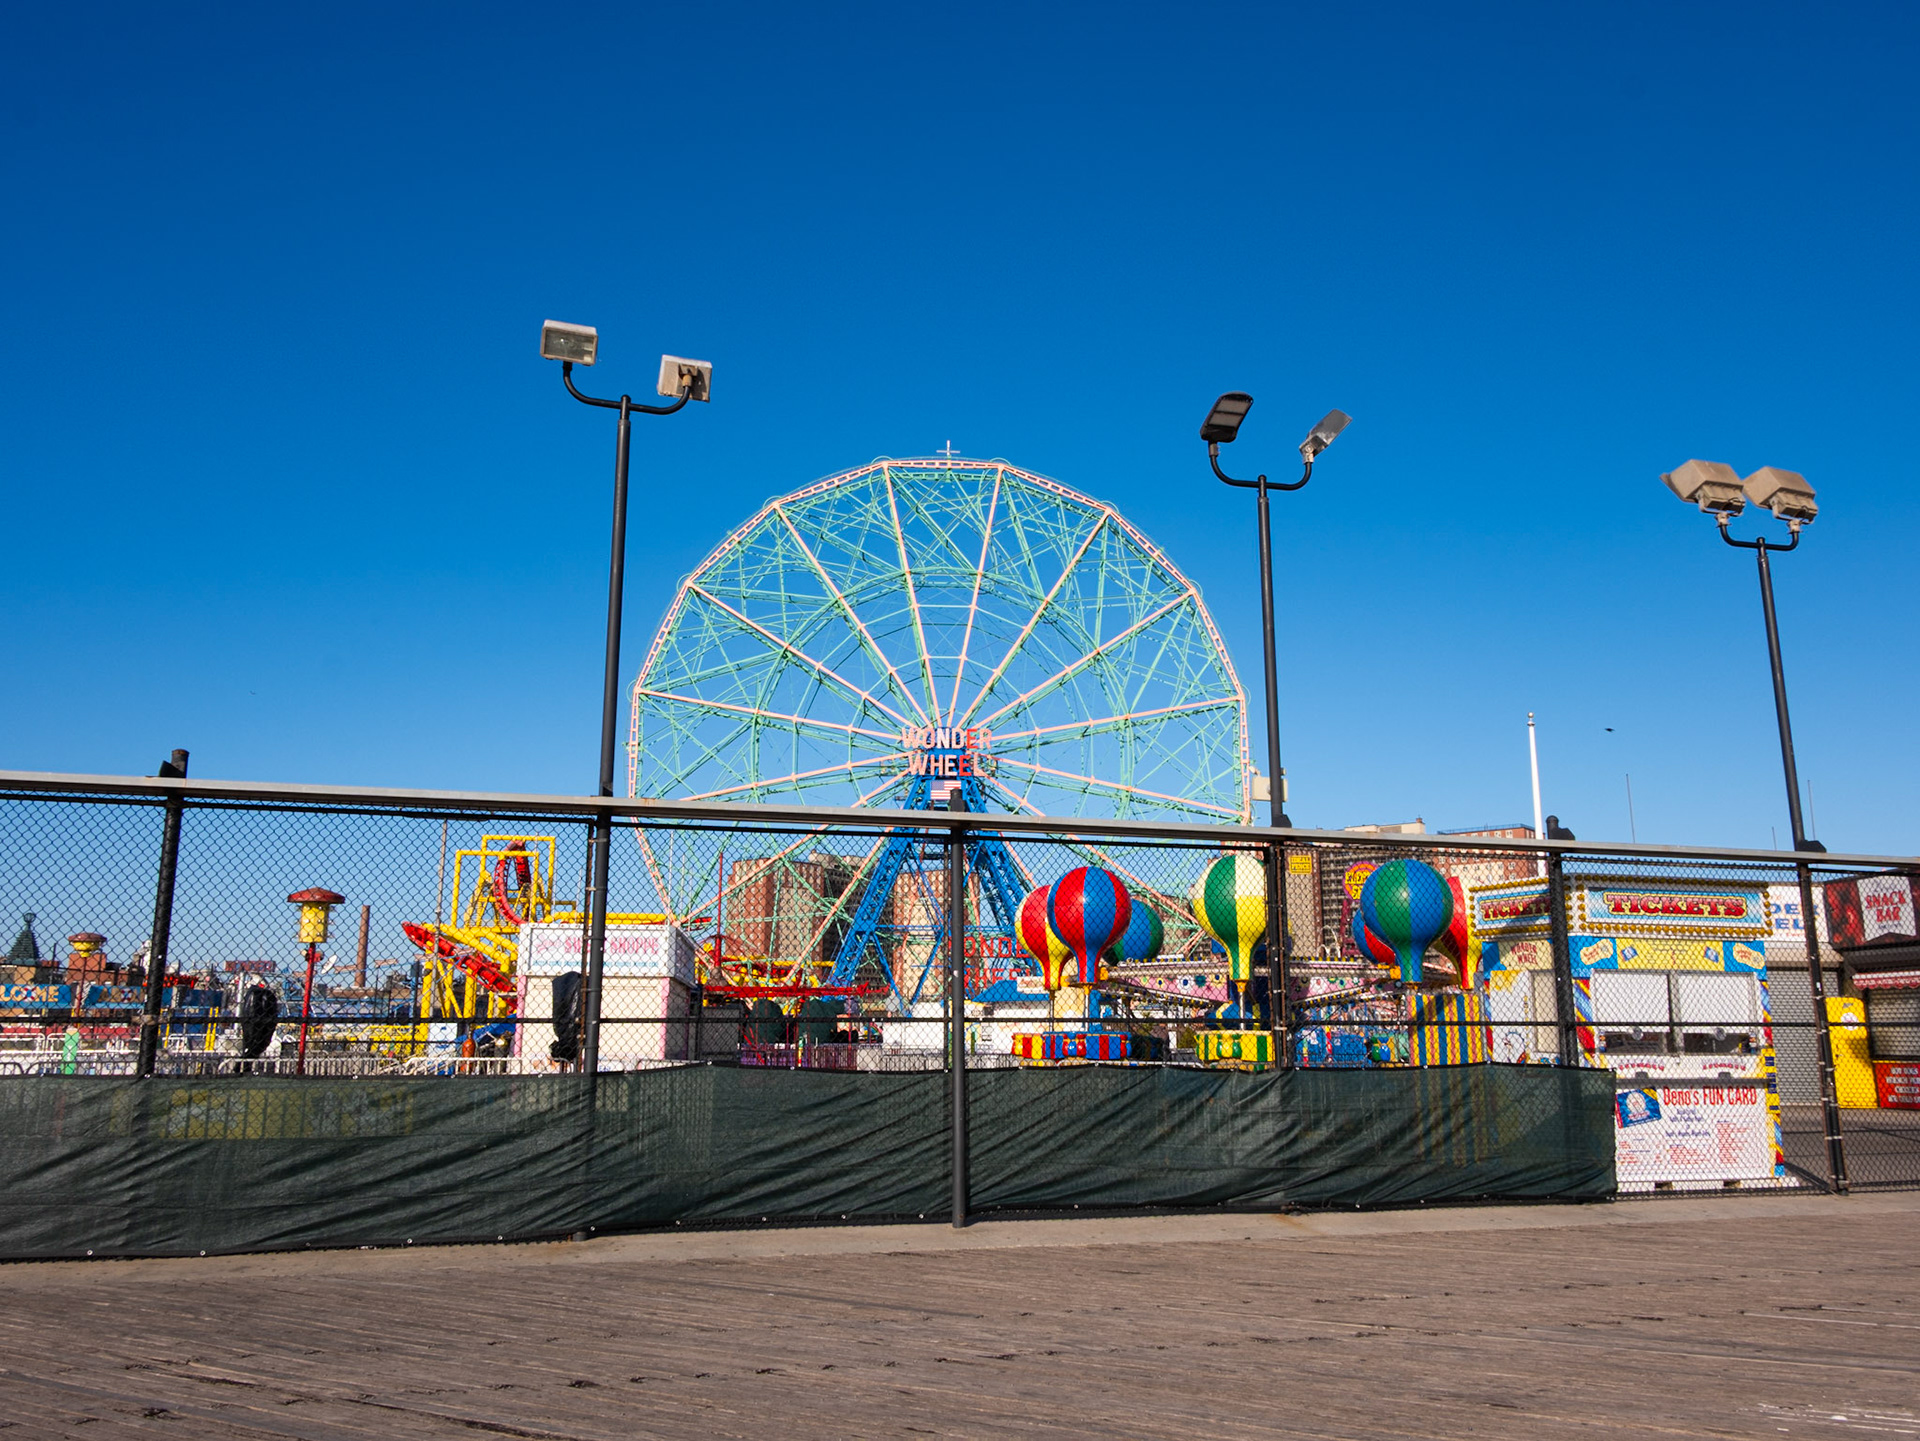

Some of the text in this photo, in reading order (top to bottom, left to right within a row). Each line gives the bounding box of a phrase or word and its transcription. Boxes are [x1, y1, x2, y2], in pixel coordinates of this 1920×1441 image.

[901, 727, 992, 749] WONDER
[908, 753, 985, 776] WHEEL
[1605, 894, 1746, 916] TICKETS
[1865, 890, 1907, 910] SNACK
[1876, 907, 1902, 922] BAR
[1511, 942, 1538, 956] WONDER
[1703, 1085, 1724, 1105] FUN
[1727, 1085, 1757, 1105] CARD
